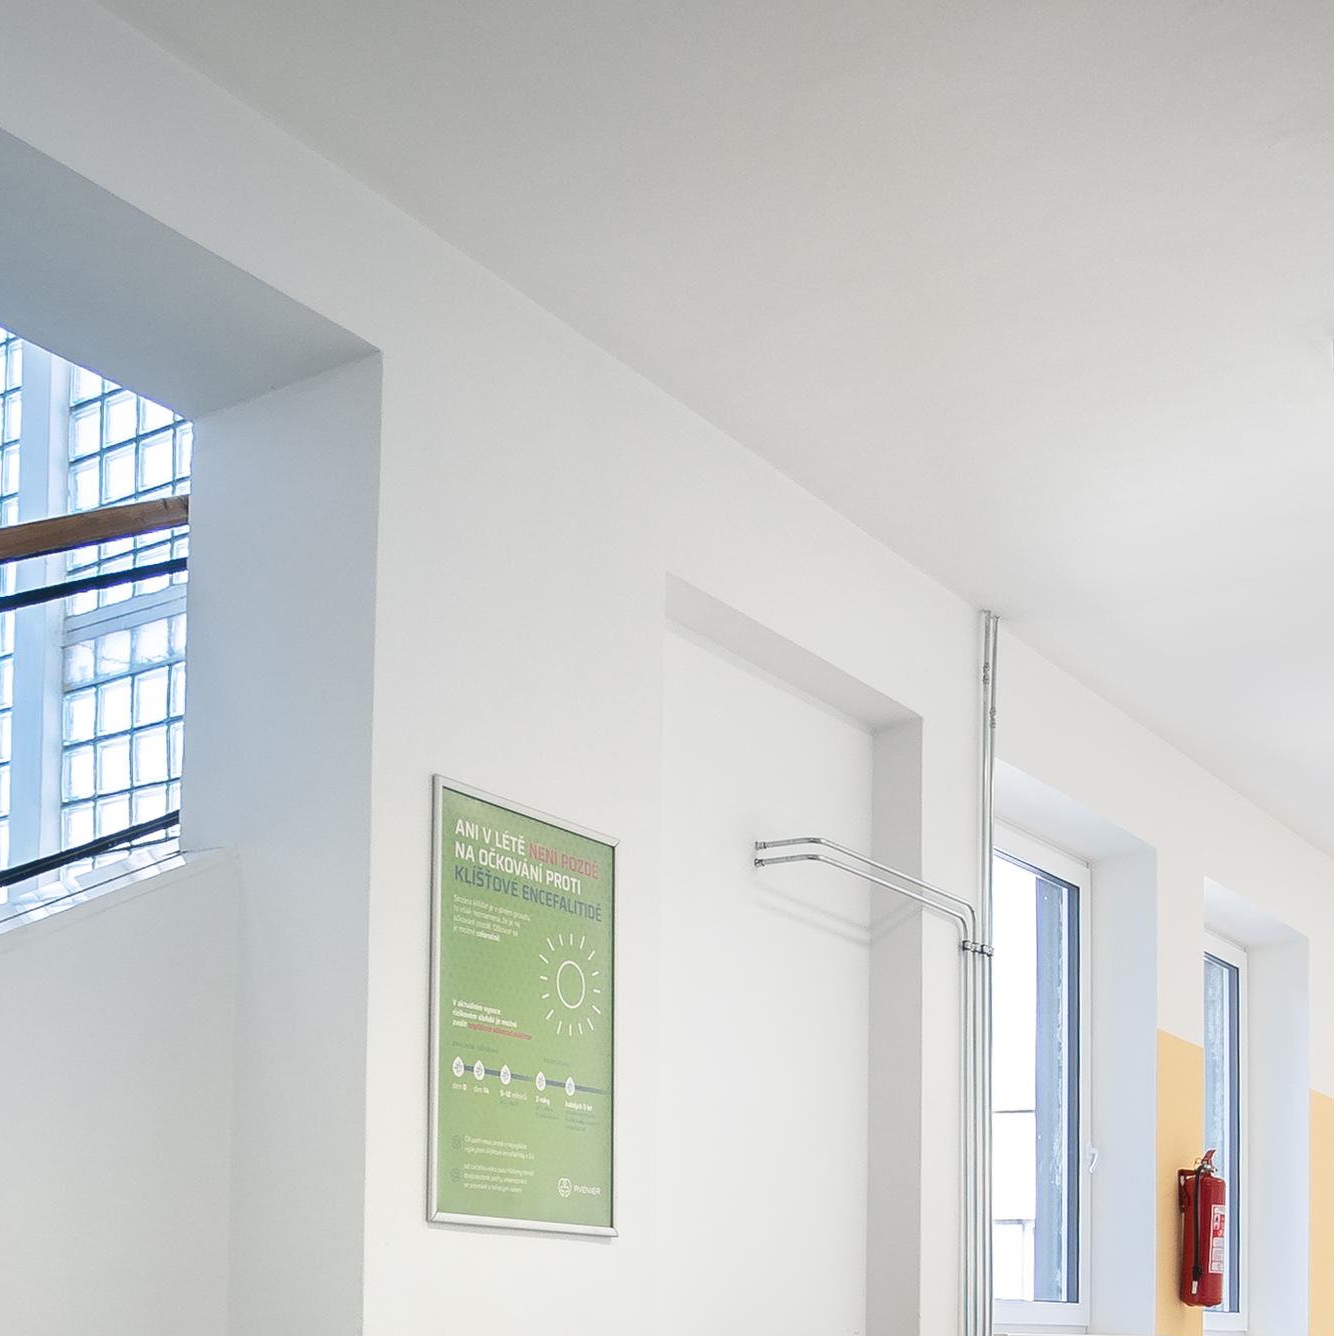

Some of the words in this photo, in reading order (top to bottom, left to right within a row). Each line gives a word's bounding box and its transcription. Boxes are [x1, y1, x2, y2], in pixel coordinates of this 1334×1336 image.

[455, 819, 479, 841] ANI
[483, 827, 492, 844] V
[495, 830, 526, 856] LÉTĚ
[529, 843, 557, 866] NENÍ
[454, 865, 519, 897] KLÍŠŤOVÉ
[455, 841, 475, 862] NA
[479, 847, 543, 884] OČKOVÁNÍ
[546, 869, 581, 895] PROTI
